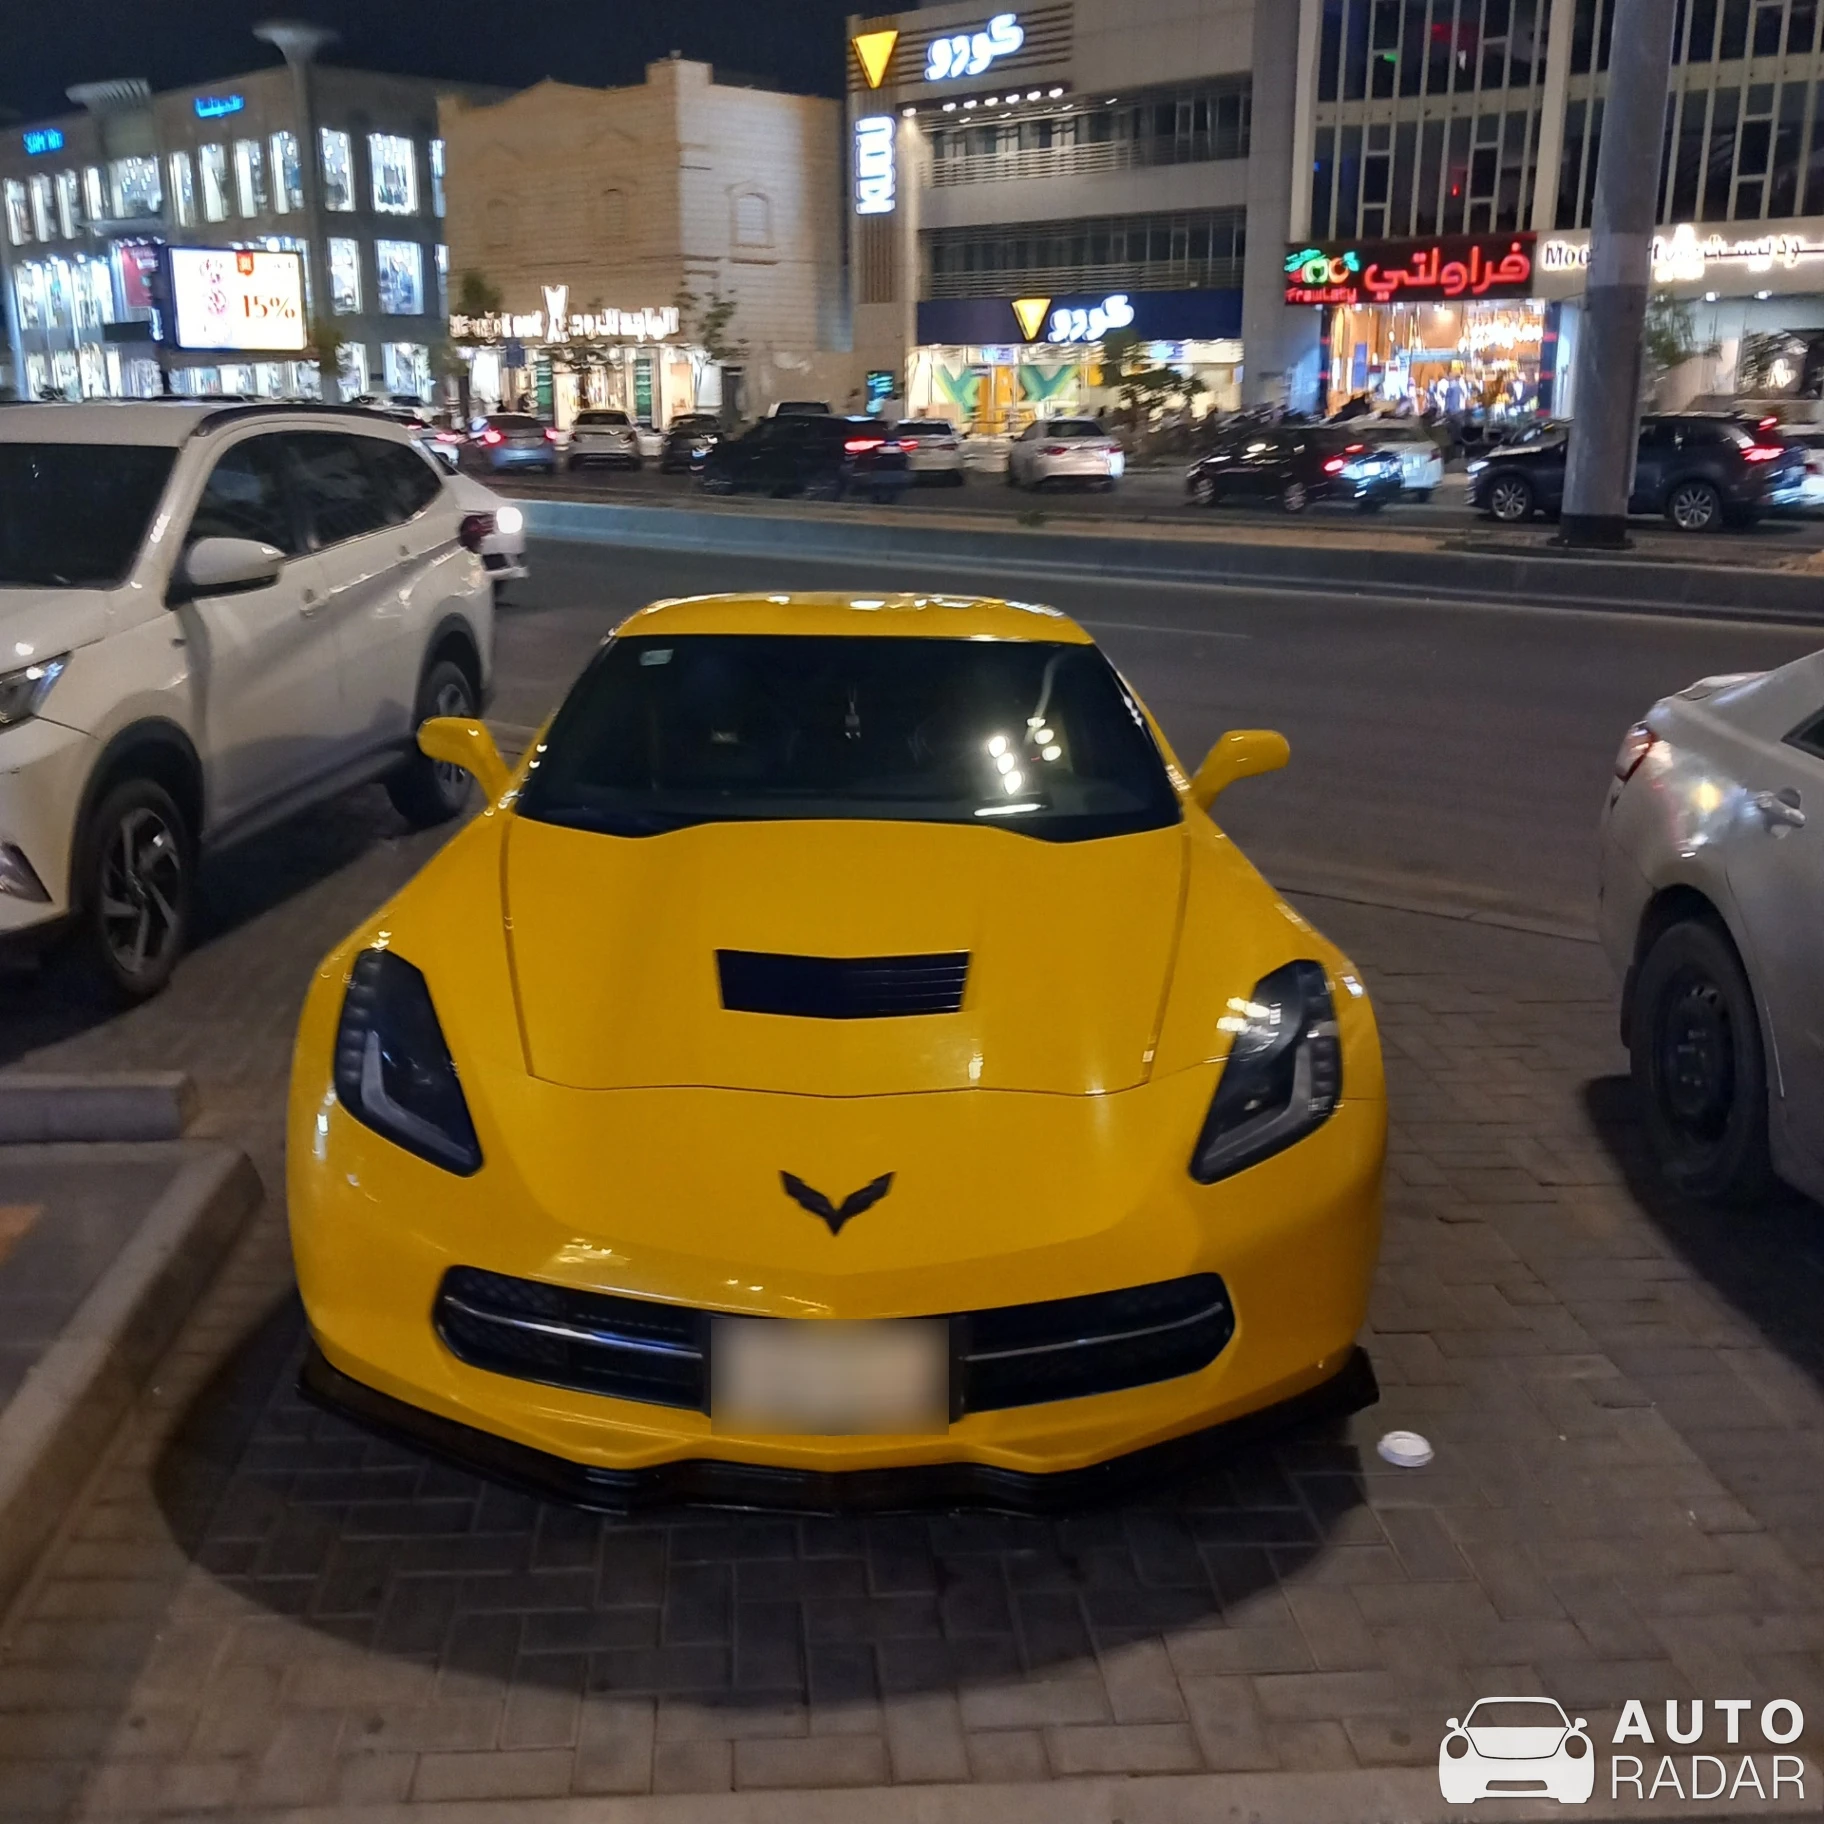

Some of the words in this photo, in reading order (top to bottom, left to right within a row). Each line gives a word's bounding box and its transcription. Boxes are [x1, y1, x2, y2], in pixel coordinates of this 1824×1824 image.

[855, 116, 896, 215] KUDU
[1364, 242, 1531, 301] فراولتي
[1544, 242, 1592, 267] Moo
[243, 294, 296, 319] 15%
